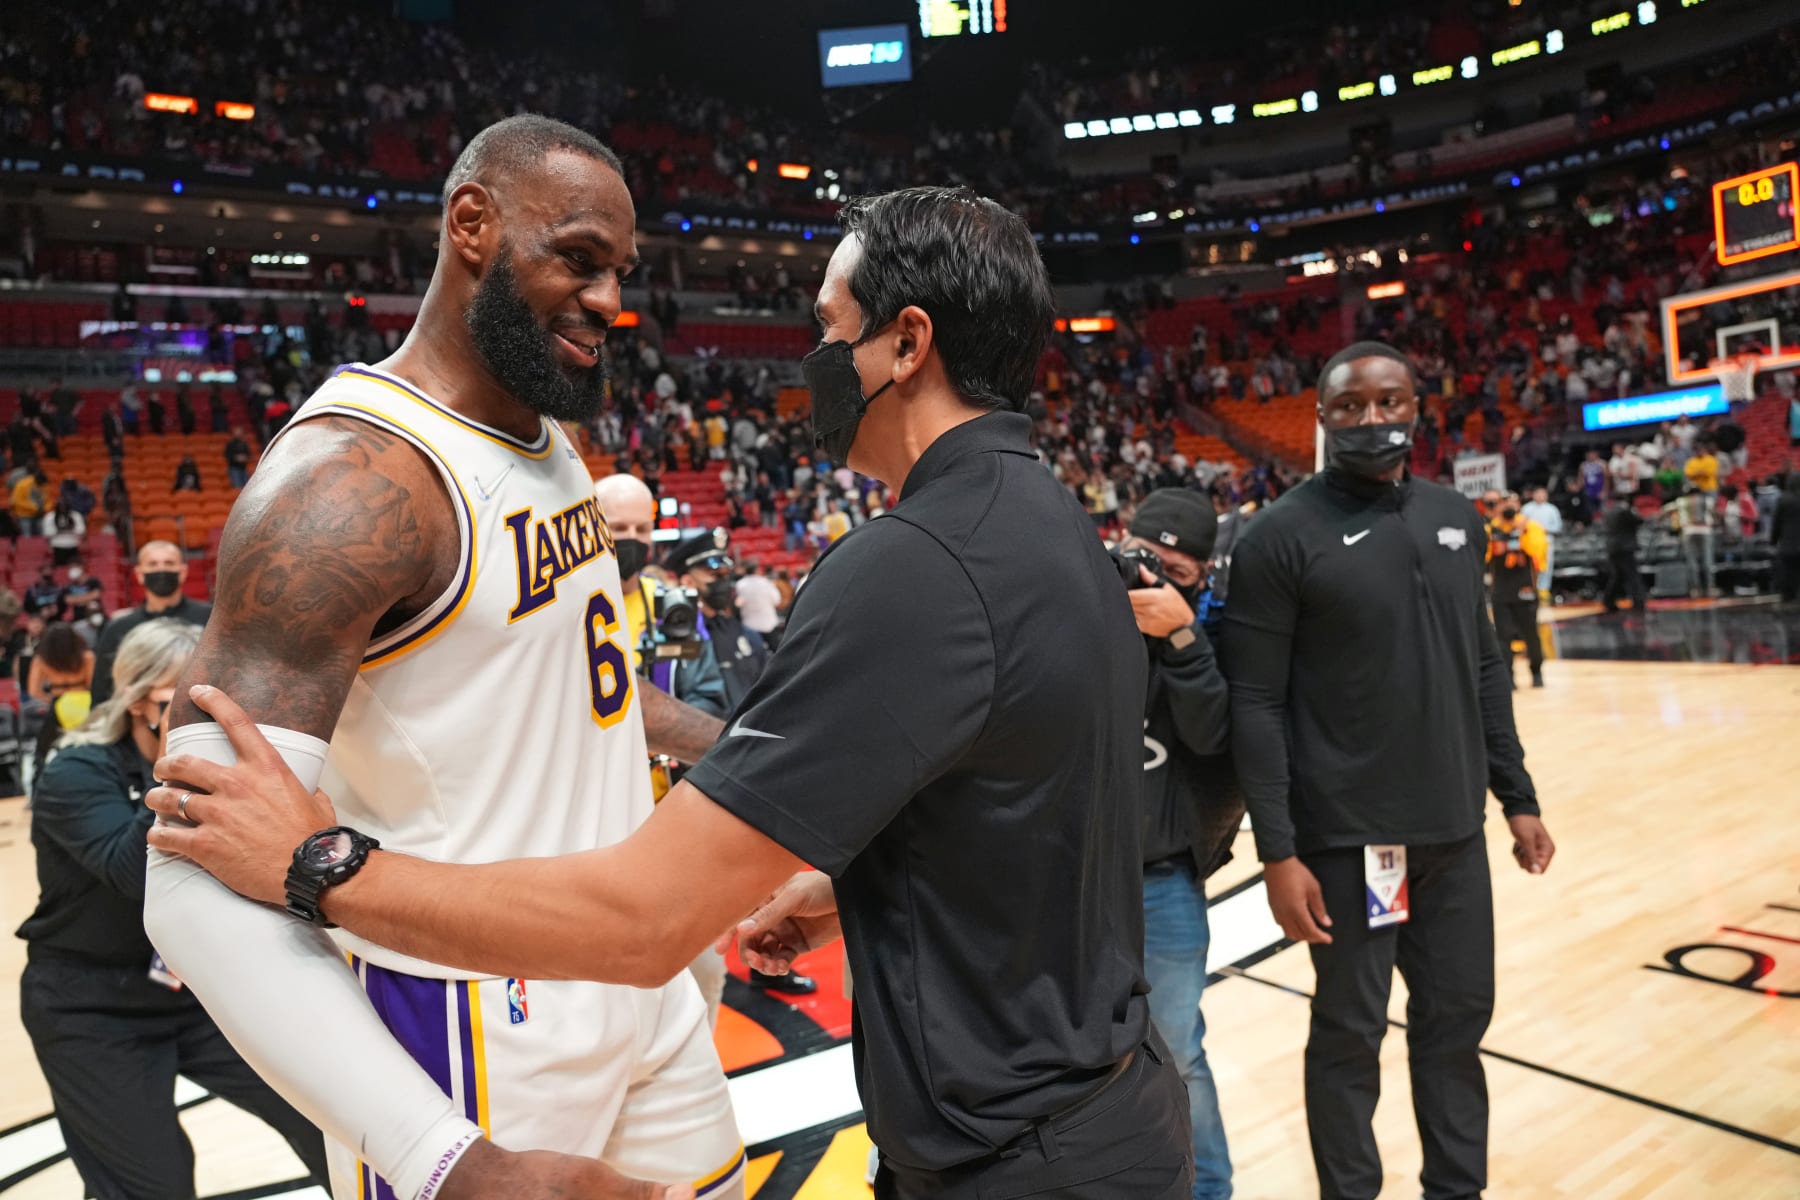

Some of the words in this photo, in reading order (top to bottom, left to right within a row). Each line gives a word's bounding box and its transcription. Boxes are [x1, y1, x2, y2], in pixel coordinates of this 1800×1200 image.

[1738, 177, 1774, 206] 0.0
[504, 493, 617, 625] LAKERS
[584, 589, 634, 730] 6
